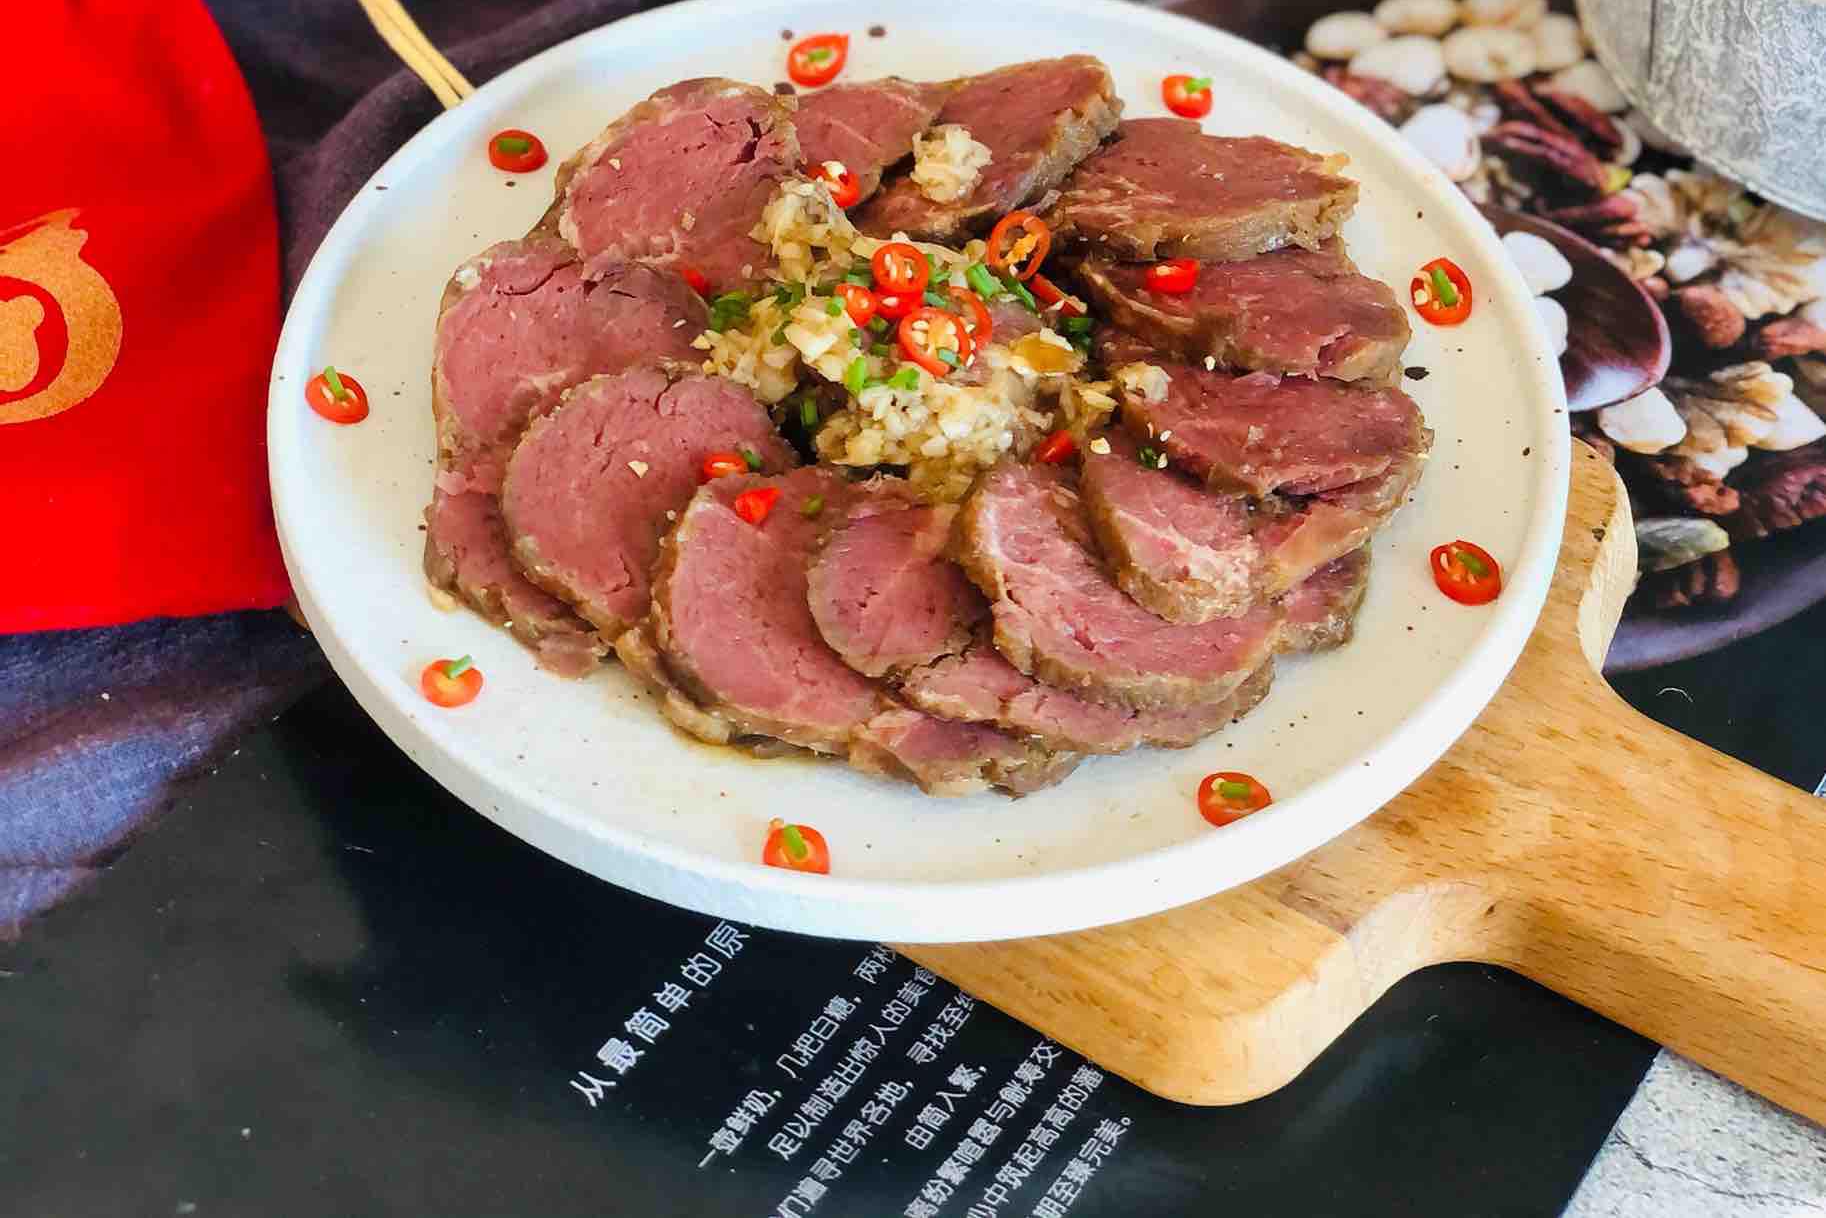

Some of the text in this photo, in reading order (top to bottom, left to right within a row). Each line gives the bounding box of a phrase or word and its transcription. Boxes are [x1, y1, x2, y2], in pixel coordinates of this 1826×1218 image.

[568, 920, 752, 1109] 从最简单的原
[903, 1037, 1063, 1218] 离纷繁喧嚣与觥筹交
